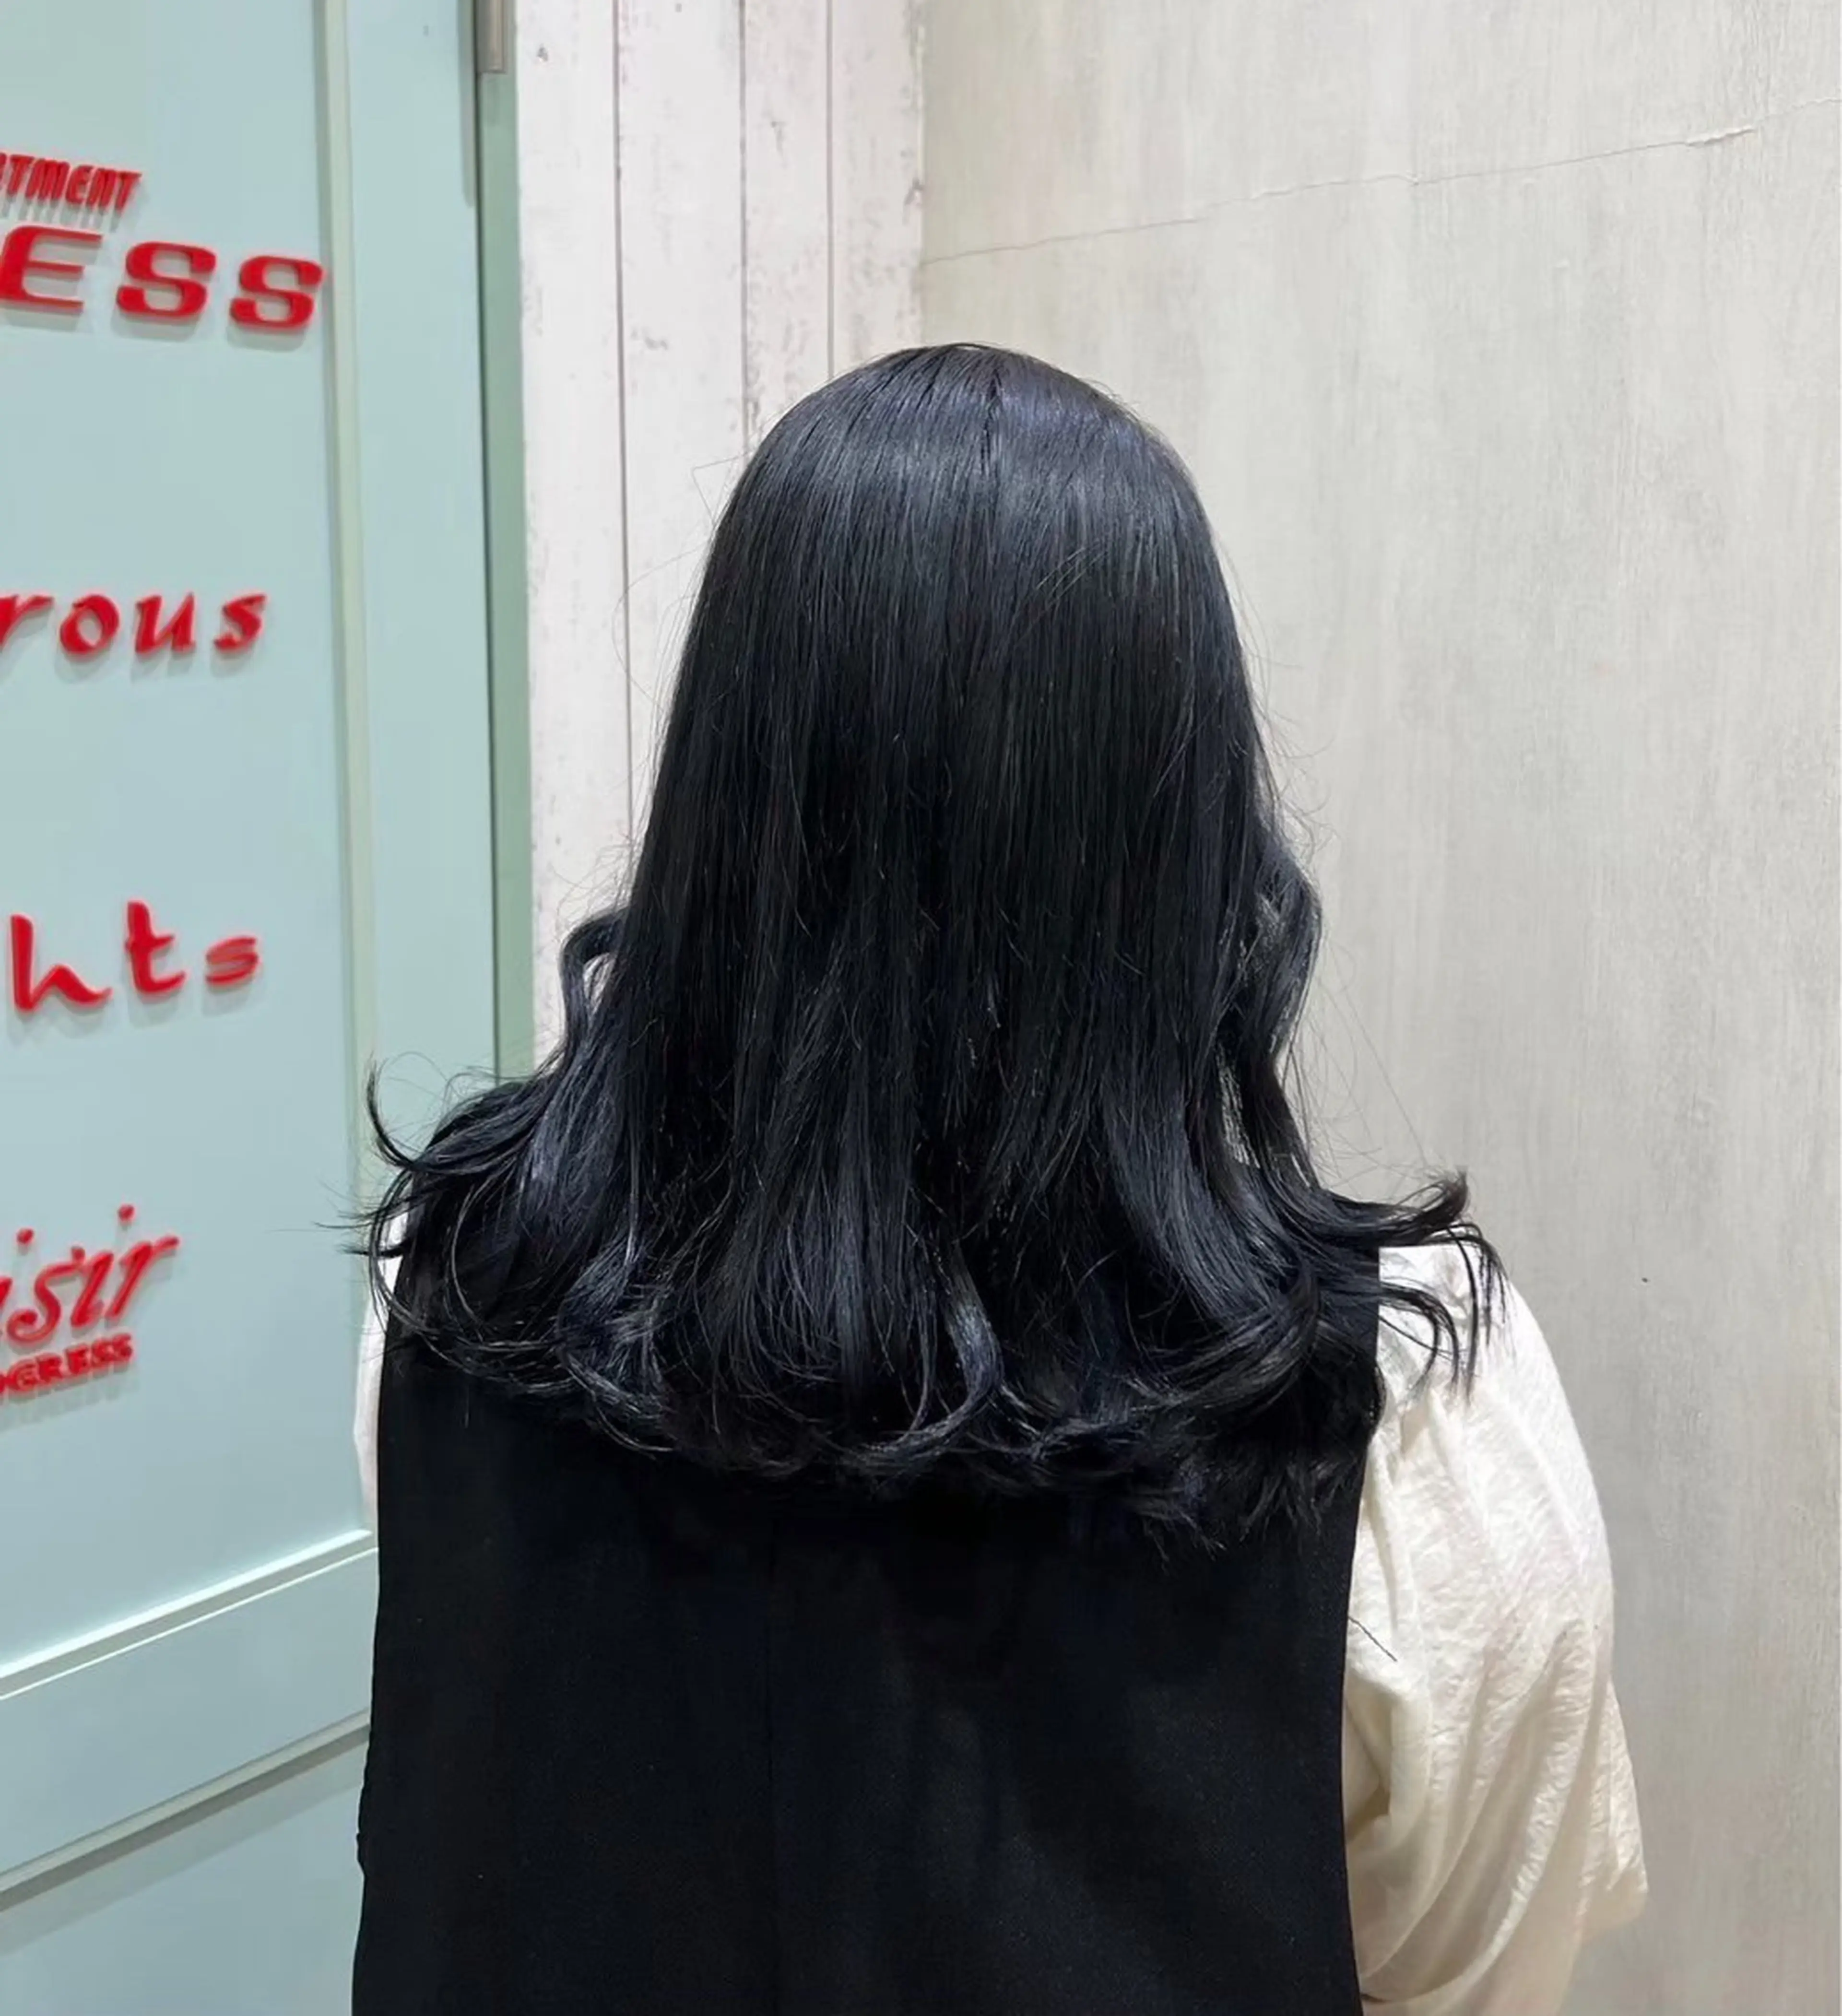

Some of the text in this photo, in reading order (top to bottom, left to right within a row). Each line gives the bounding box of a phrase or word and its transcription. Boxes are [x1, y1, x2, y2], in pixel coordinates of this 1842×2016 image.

[0, 152, 142, 214] TMENT
[0, 224, 323, 331] ESS
[11, 900, 259, 1012] hts
[0, 1332, 133, 1395] GRESS
